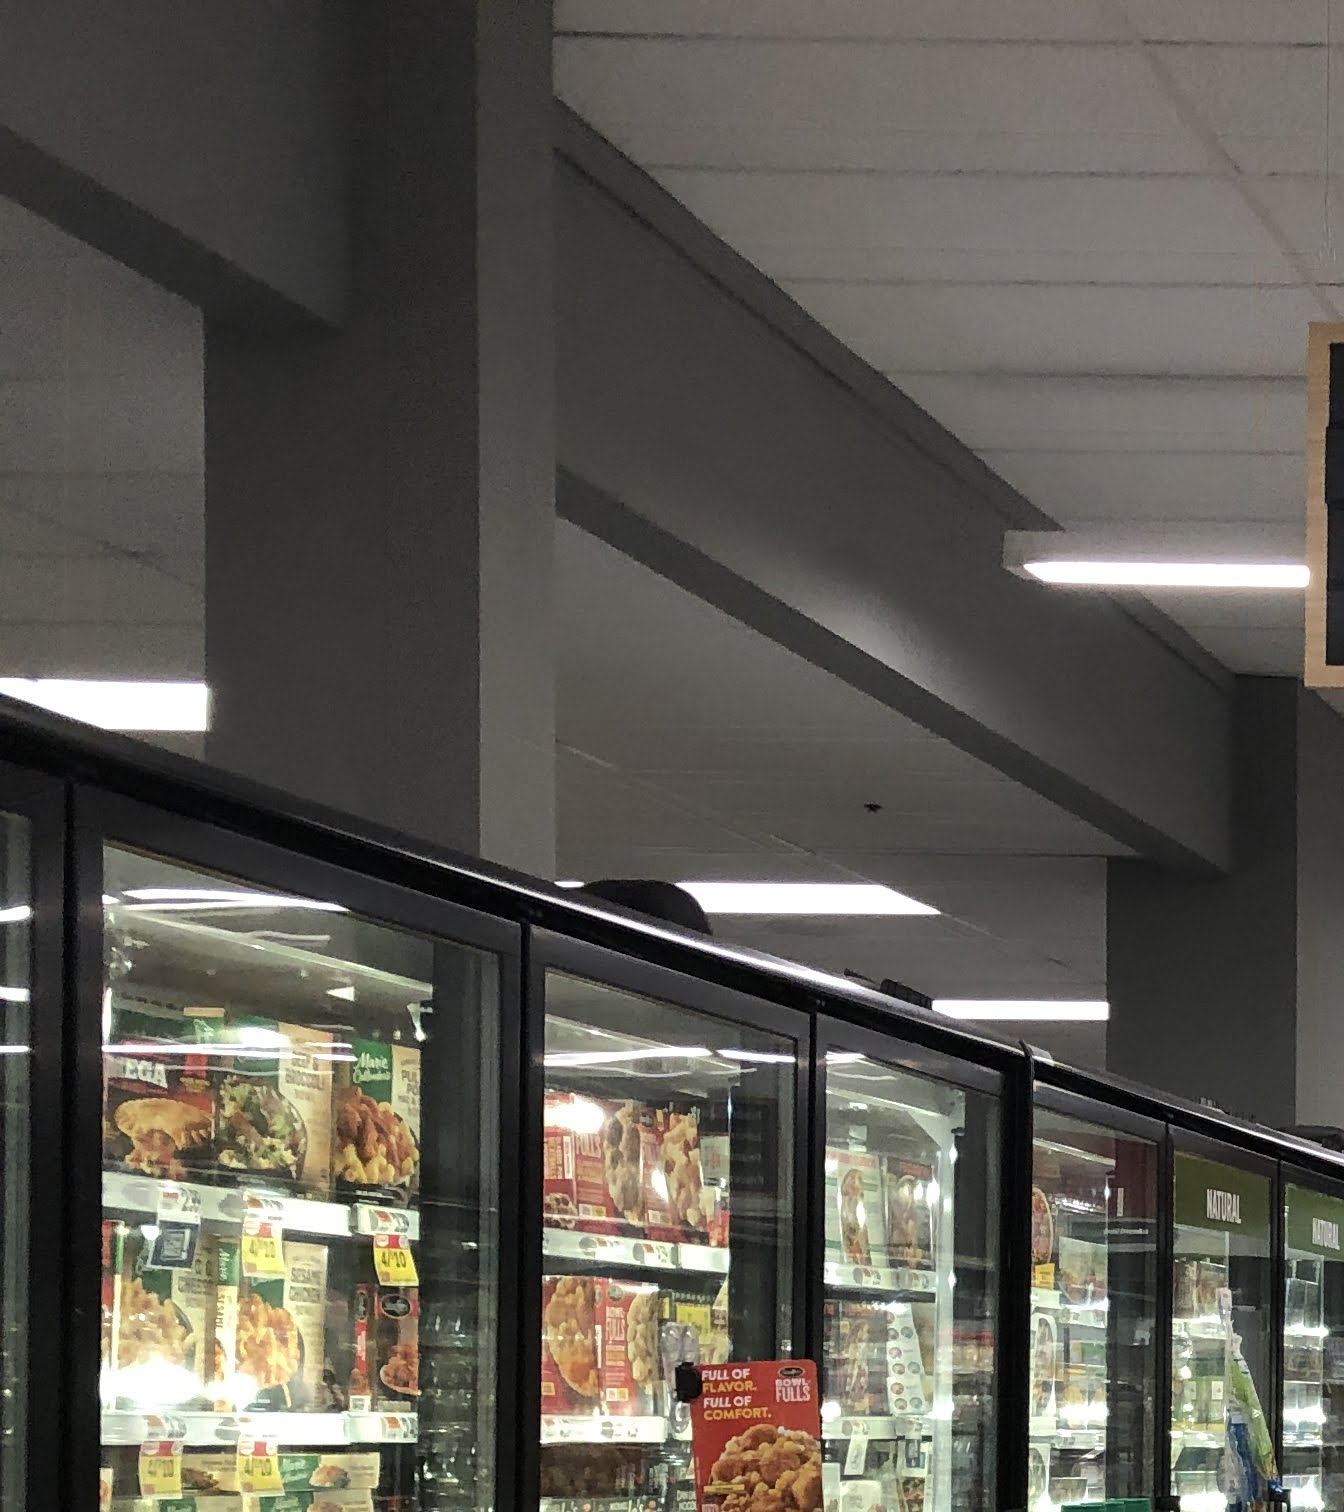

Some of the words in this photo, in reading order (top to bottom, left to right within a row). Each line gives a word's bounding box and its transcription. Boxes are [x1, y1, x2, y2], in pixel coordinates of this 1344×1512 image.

[1206, 1188, 1242, 1224] NATURAL
[701, 1368, 730, 1382] FULL
[731, 1368, 751, 1380] OF
[702, 1380, 757, 1393] FLAVOR.
[775, 1385, 811, 1403] FULLS
[703, 1396, 732, 1409] FULL
[733, 1395, 752, 1408] OF
[703, 1406, 772, 1421] COMFORT.
